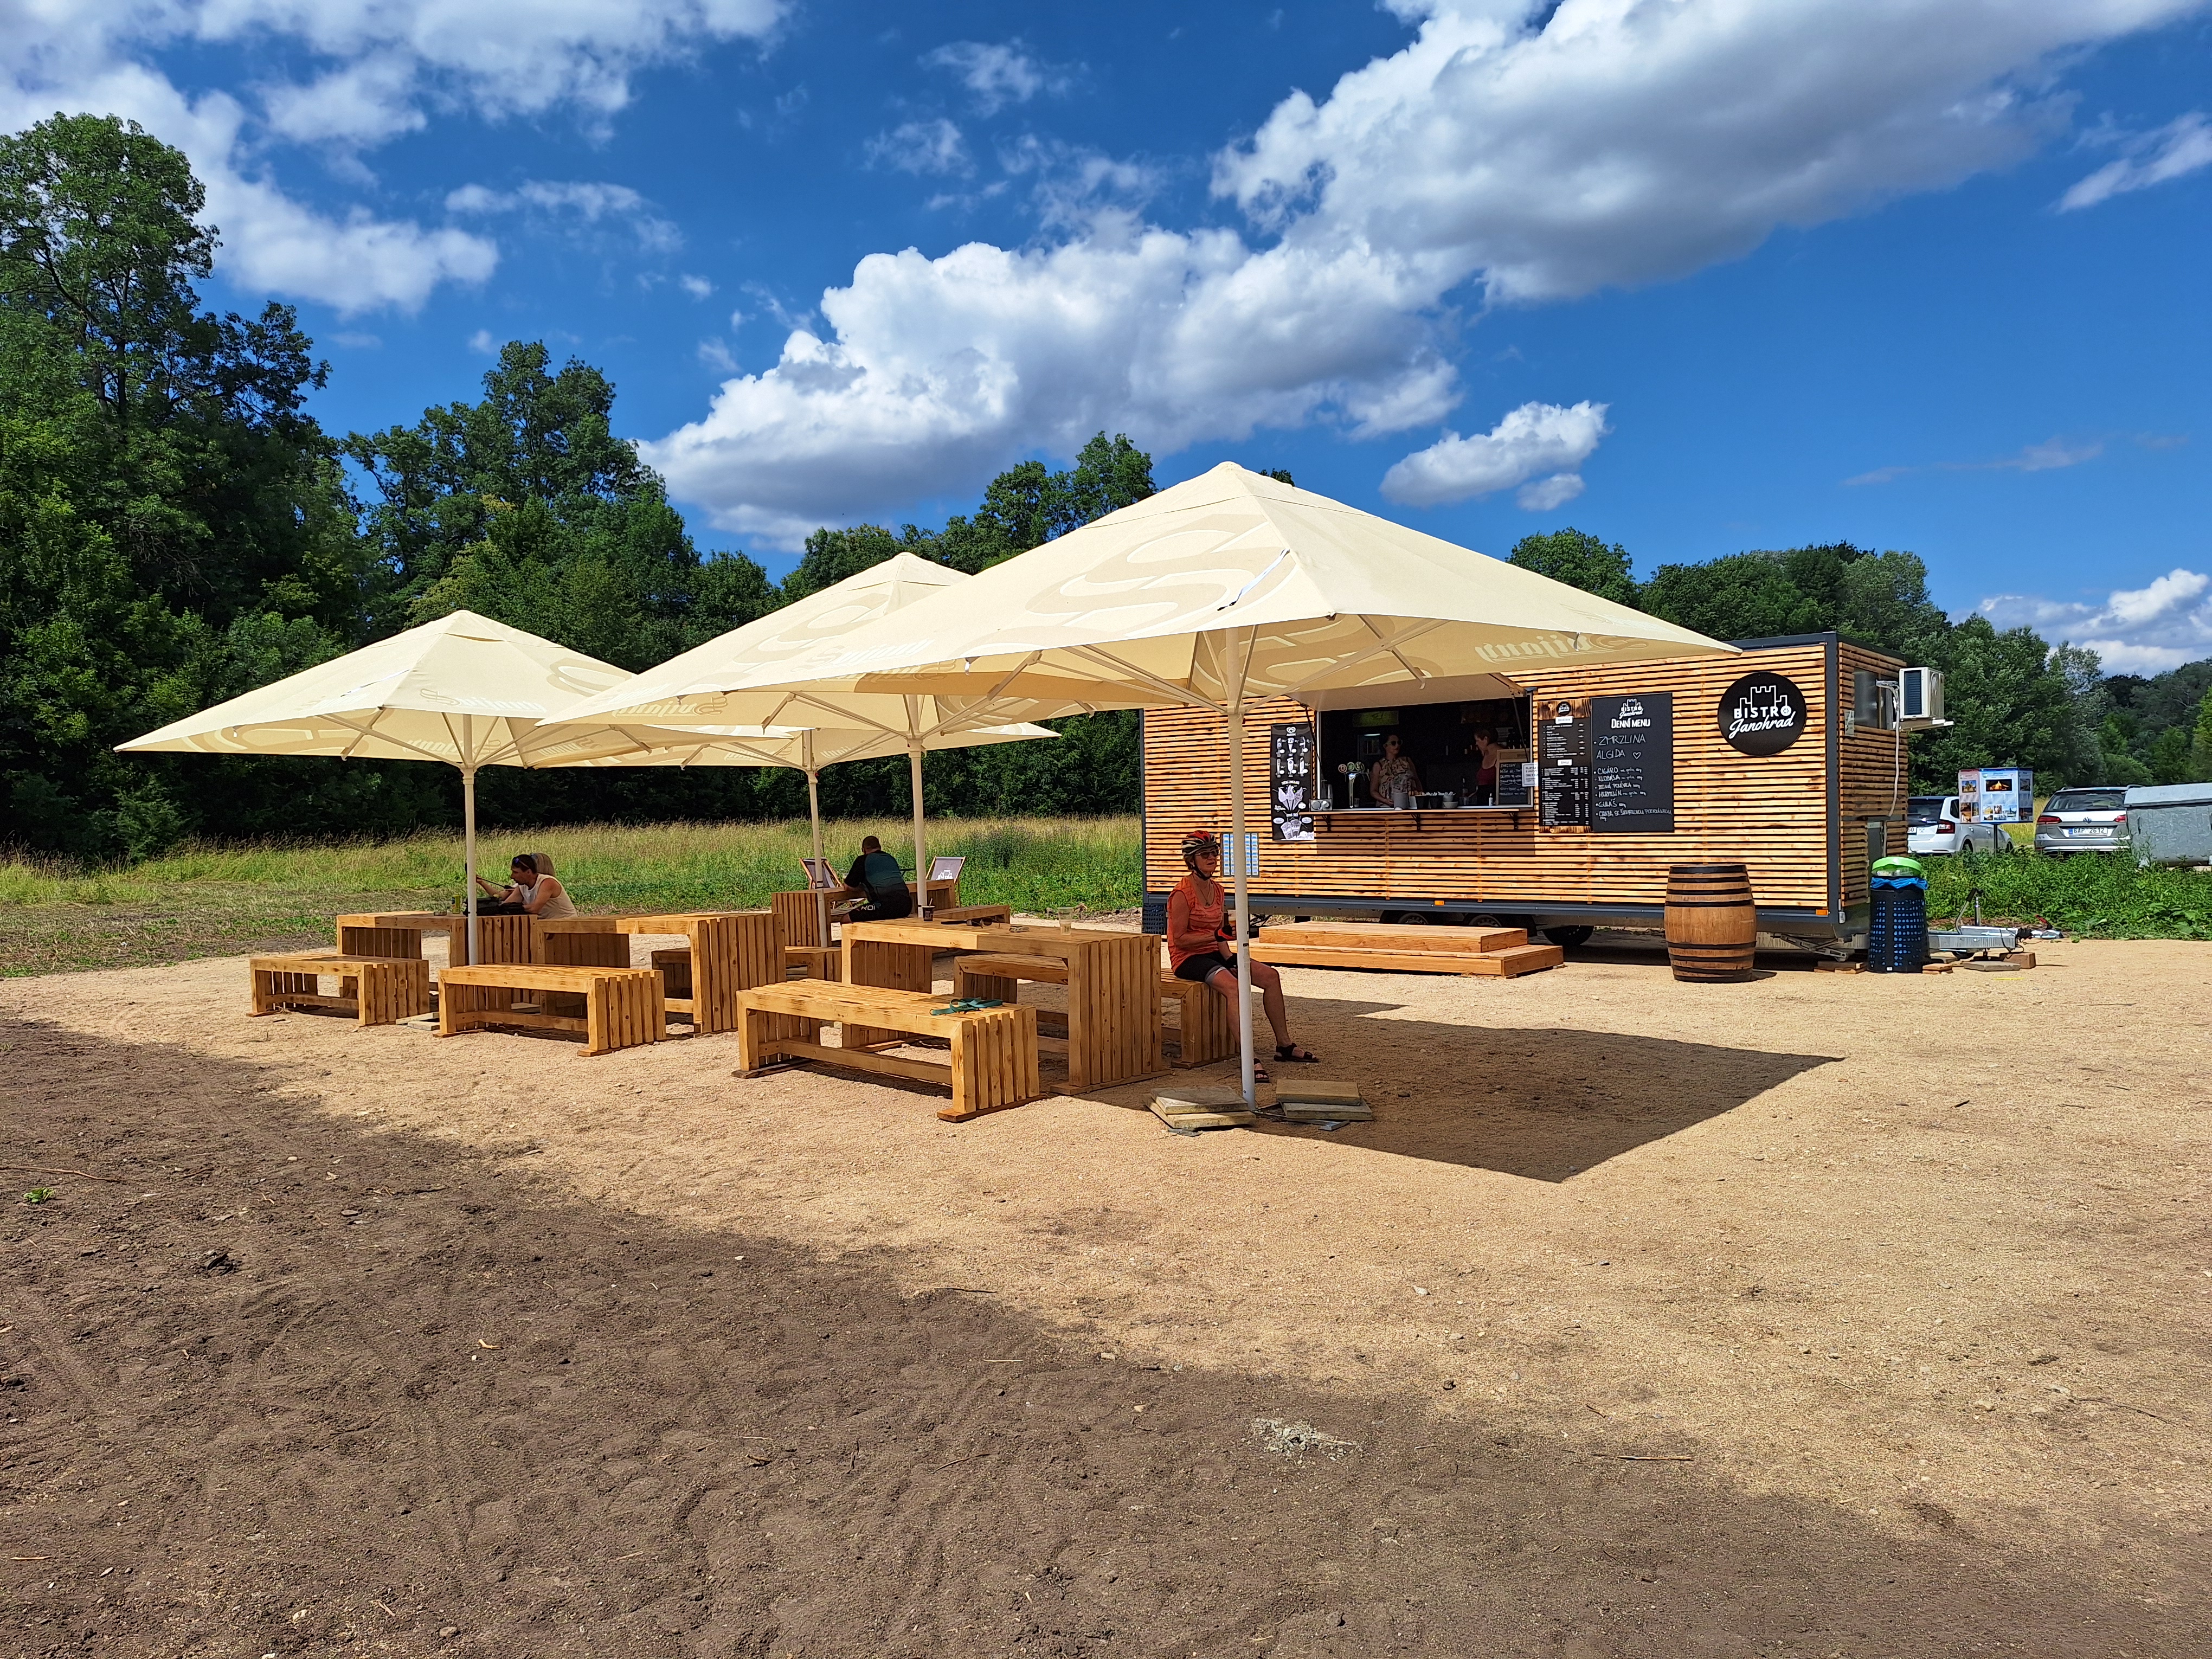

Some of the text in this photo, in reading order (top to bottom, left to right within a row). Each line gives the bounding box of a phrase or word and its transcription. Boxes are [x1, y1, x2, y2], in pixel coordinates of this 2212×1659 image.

[1734, 705, 1792, 719] BISTRO
[1611, 717, 1651, 729] DENNÍ MENU
[1728, 711, 1796, 739] Janohrad
[1598, 734, 1646, 745] ZMRZLINA
[1596, 749, 1626, 759] ALGIDA
[1597, 766, 1618, 775] CIGÁRO
[1598, 798, 1617, 807] GULÁŠ
